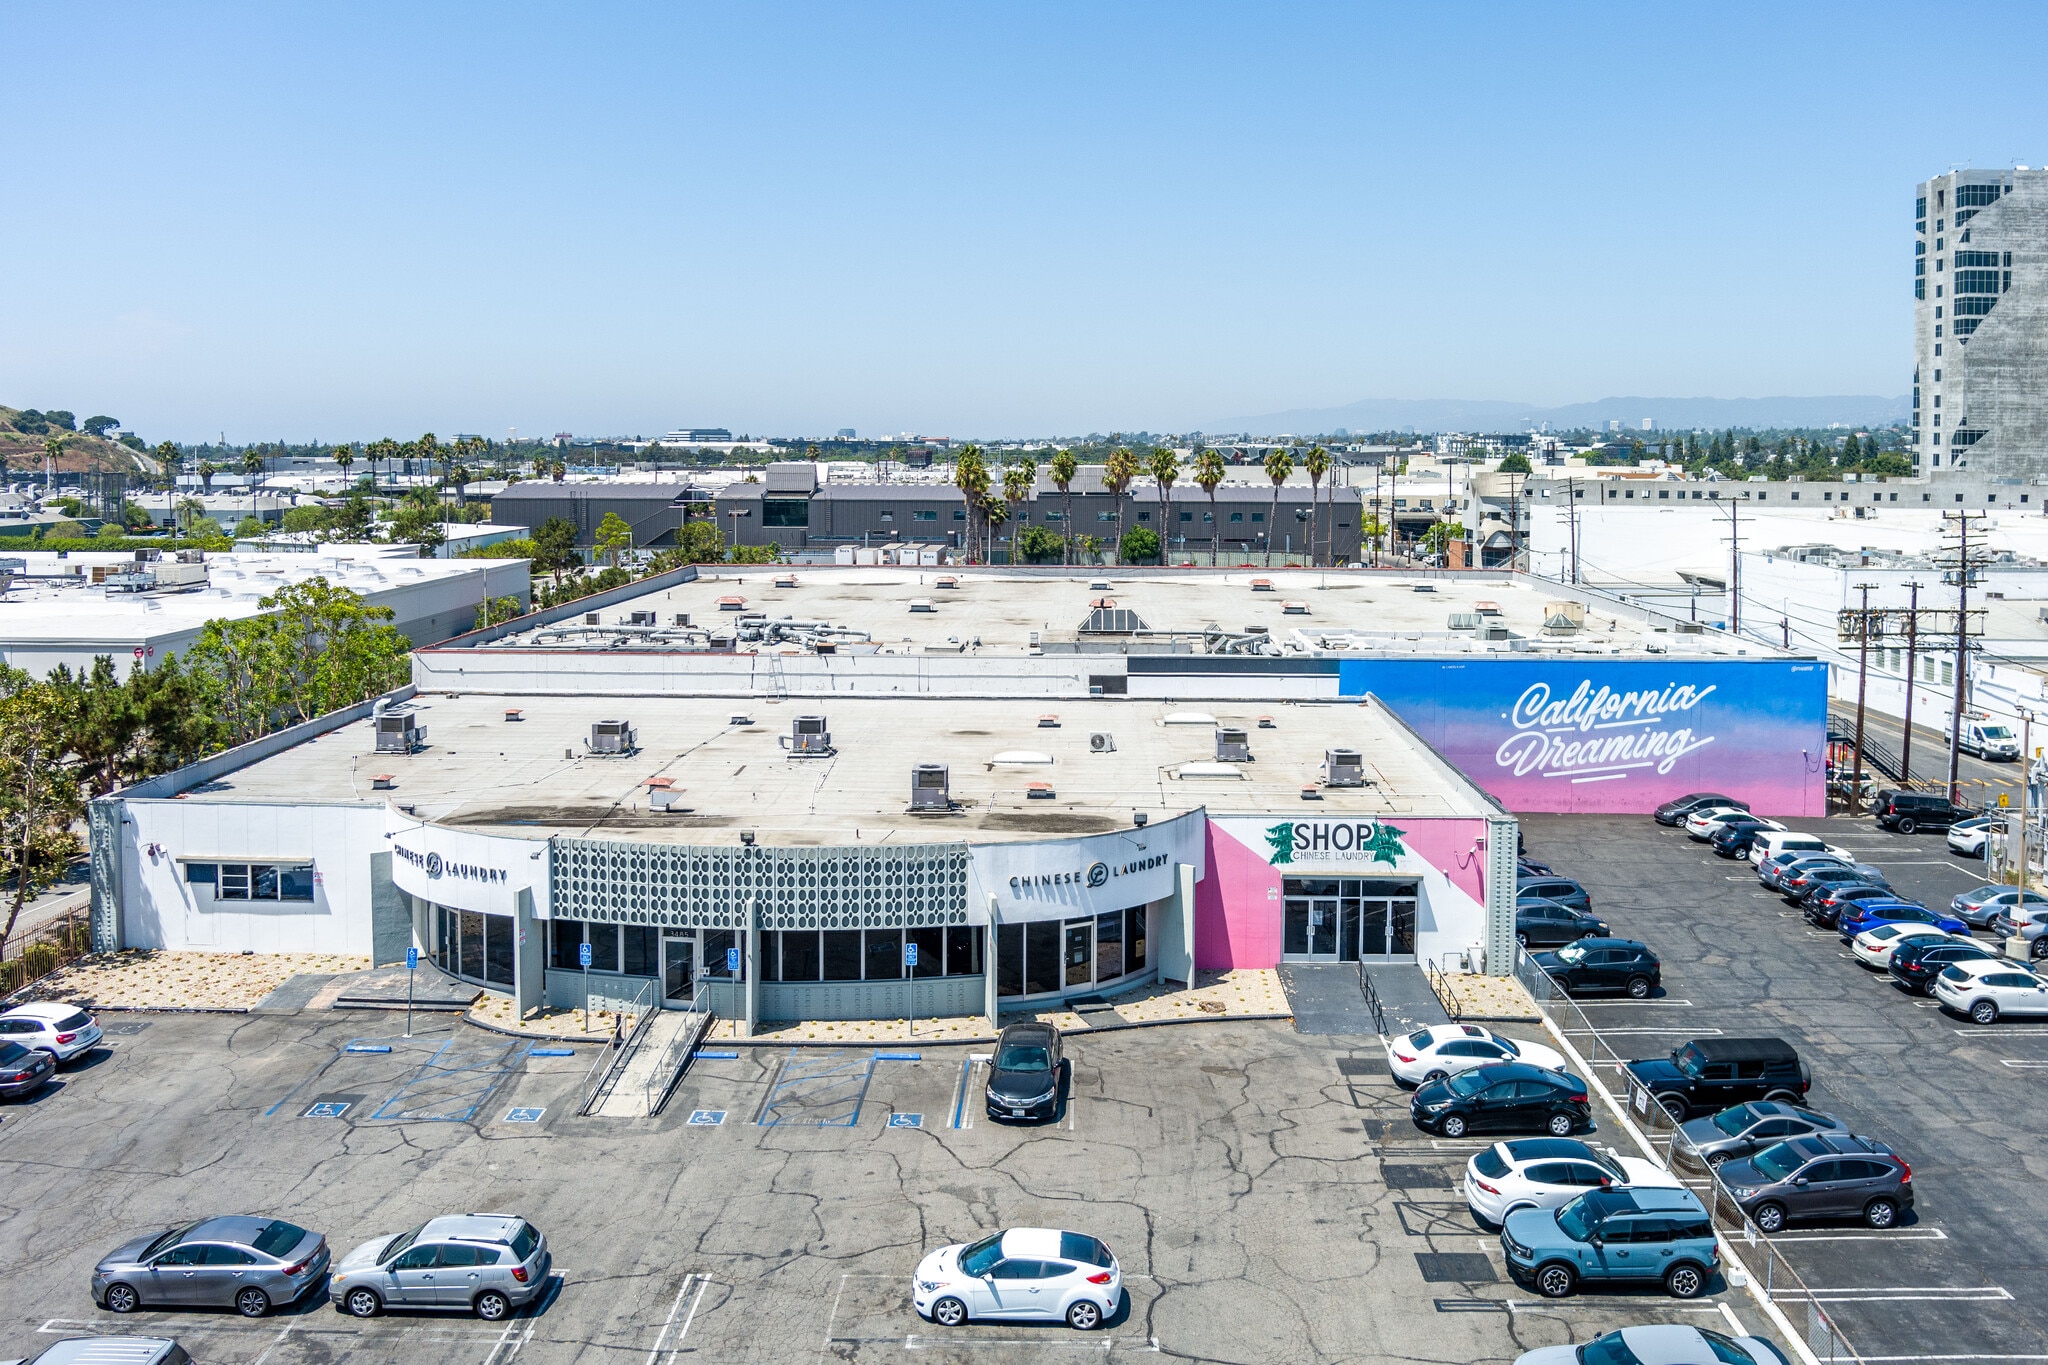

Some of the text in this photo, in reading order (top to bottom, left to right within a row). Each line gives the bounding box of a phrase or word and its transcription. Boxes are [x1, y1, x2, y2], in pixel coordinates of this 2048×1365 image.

[1512, 679, 1717, 732] California
[1496, 726, 1715, 777] Dreaming
[1294, 823, 1372, 851] SHOP
[445, 861, 507, 881] LAUNDRY
[1009, 853, 1169, 888] CHINESE LAUNDRY
[1293, 851, 1375, 861] CHINESE LAUNDRY
